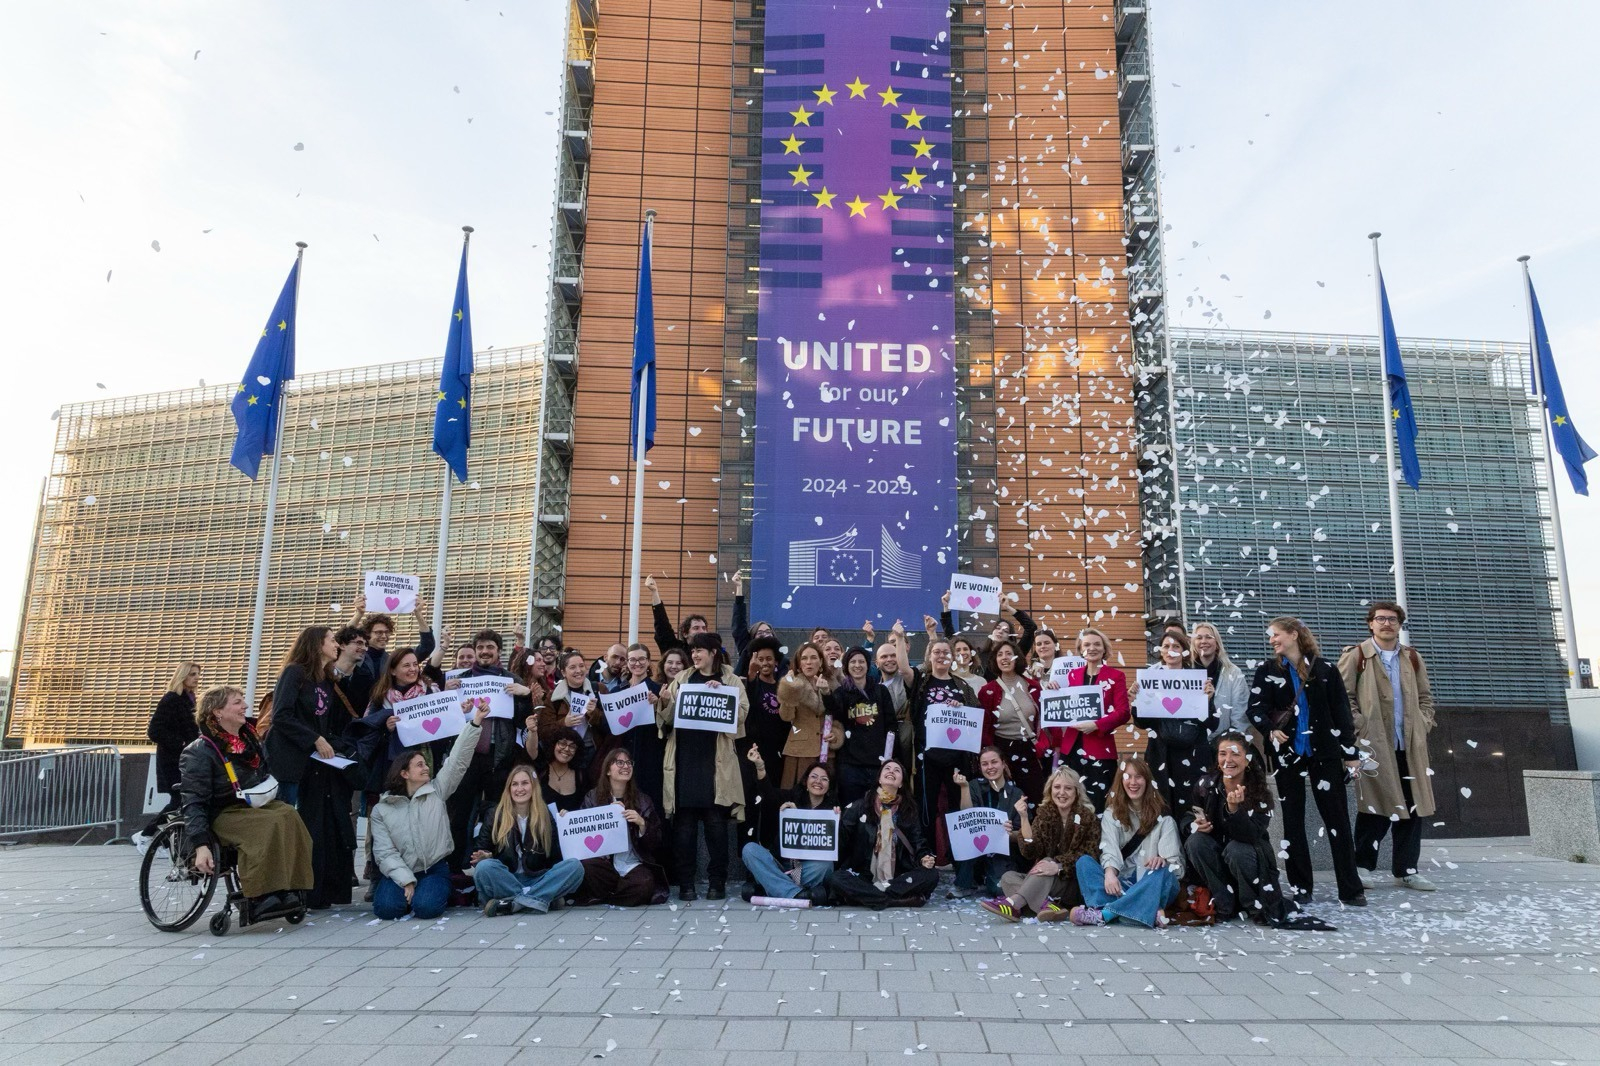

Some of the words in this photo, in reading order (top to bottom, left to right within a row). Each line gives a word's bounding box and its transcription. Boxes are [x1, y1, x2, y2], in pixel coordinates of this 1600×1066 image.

[783, 340, 932, 373] UNITED
[819, 382, 852, 401] for
[859, 387, 897, 402] our
[792, 417, 923, 445] FUTURE
[802, 478, 848, 493] 2024
[866, 479, 912, 495] 2029
[375, 581, 414, 591] FUNDEMENTAL
[376, 575, 404, 584] ABORTION
[954, 582, 967, 590] WE
[969, 582, 999, 594] WON!!!
[1140, 680, 1159, 690] WE
[1161, 680, 1202, 690] WON!!!
[396, 702, 428, 716] ABORTION
[429, 699, 436, 707] IS
[436, 696, 458, 704] BODILY
[615, 691, 648, 710] WON!!!
[683, 695, 698, 705] MY
[700, 696, 728, 708] VOICE
[1048, 700, 1061, 711] MY
[1062, 697, 1090, 708] VOICE
[408, 705, 449, 720] AUTHONOMY
[682, 706, 698, 716] MY
[698, 707, 732, 720] CHOICE
[1048, 711, 1062, 720] MY
[1064, 707, 1098, 719] CHOICE
[948, 718, 978, 728] FIGHTING
[568, 813, 605, 826] ABORTION
[958, 812, 988, 822] ABORTION
[570, 824, 596, 835] HUMAN
[598, 821, 619, 831] RIGHT
[784, 822, 800, 833] MY
[801, 822, 826, 834] VOICE
[958, 818, 1003, 830] FUNDEMENTAL
[968, 826, 986, 834] RIGHT
[784, 834, 799, 845] MY
[800, 834, 832, 846] CHOICE
